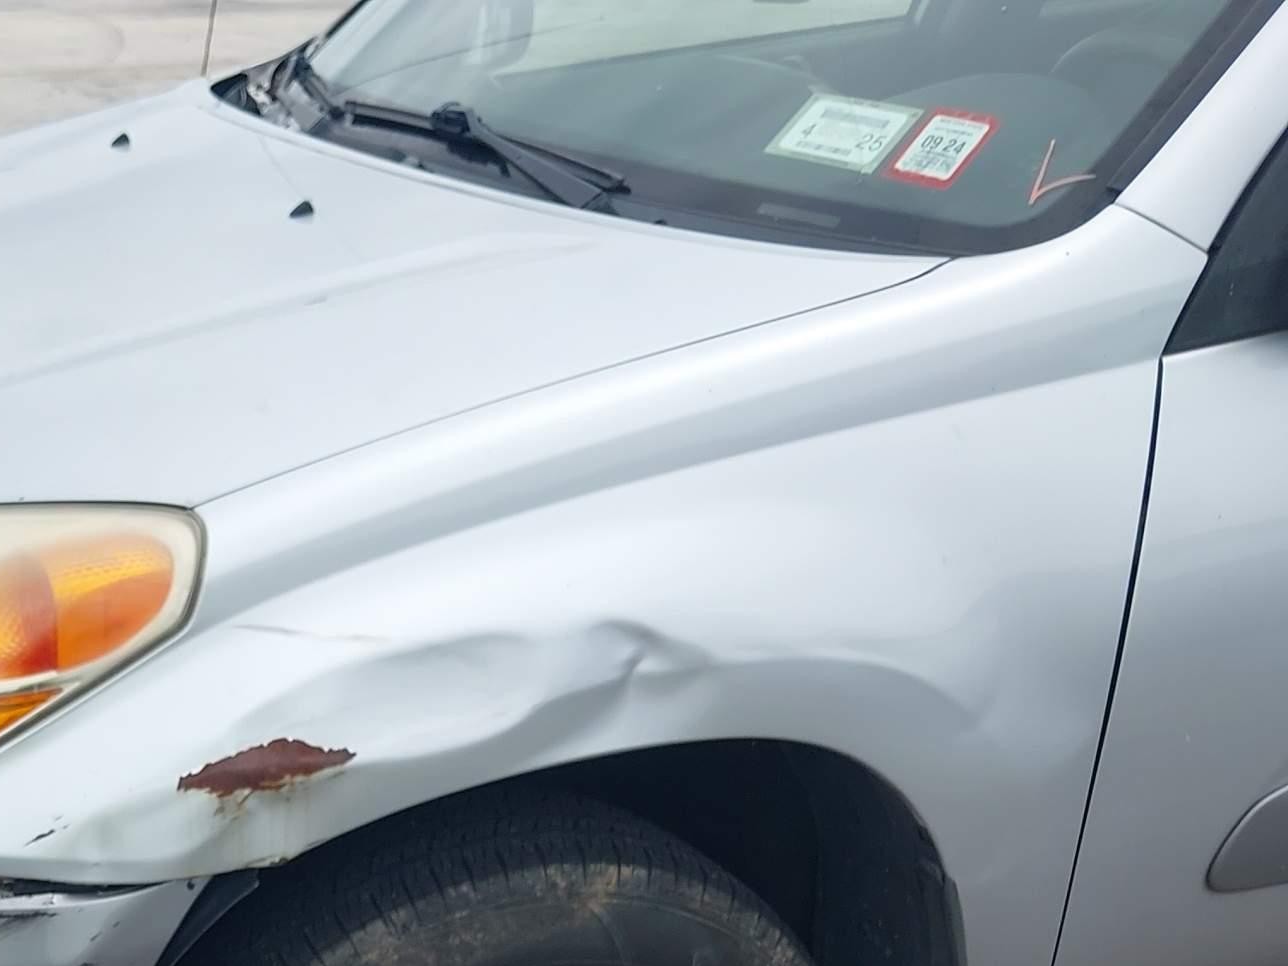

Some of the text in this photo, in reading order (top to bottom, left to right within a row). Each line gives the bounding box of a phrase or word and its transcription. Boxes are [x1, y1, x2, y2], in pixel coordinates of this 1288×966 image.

[856, 134, 885, 152] 25
[921, 134, 966, 155] 09 24
